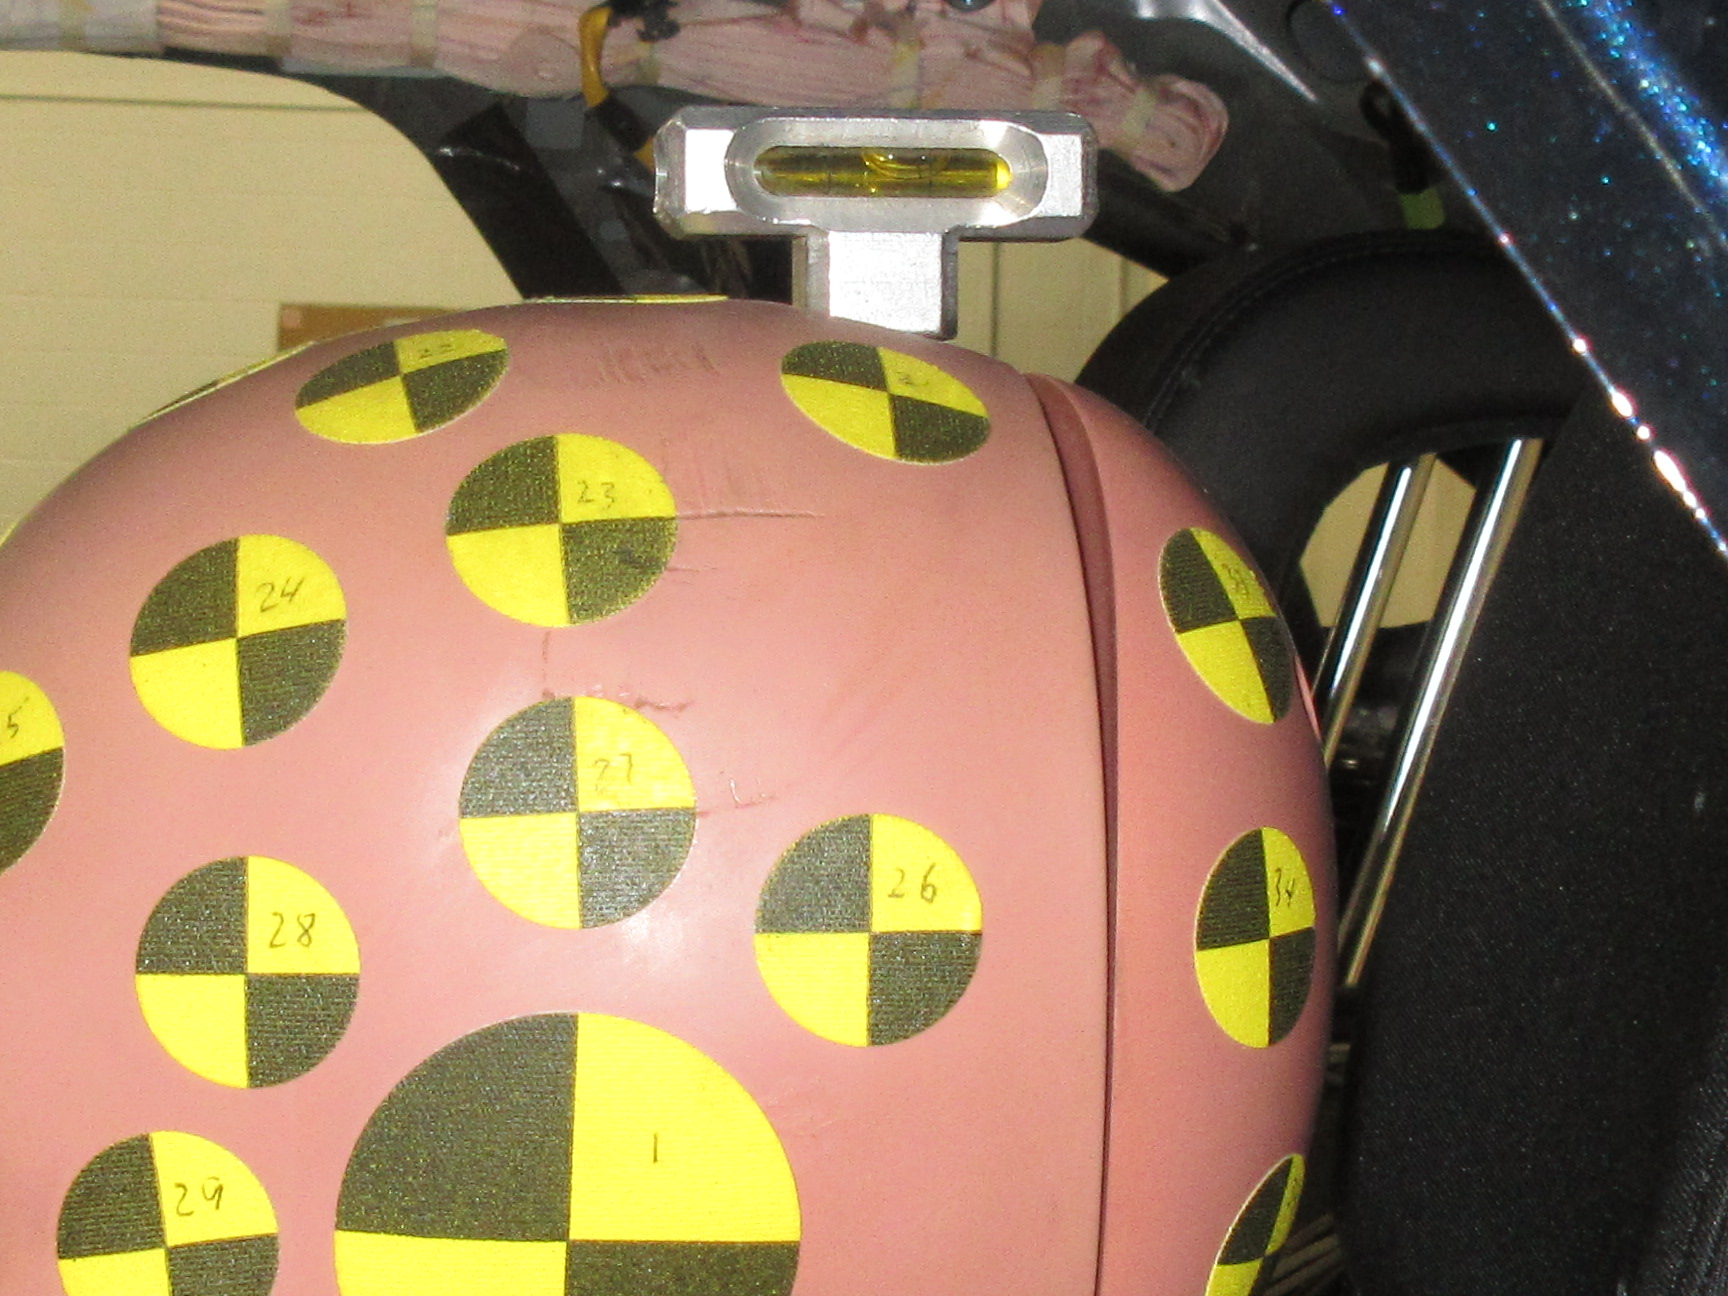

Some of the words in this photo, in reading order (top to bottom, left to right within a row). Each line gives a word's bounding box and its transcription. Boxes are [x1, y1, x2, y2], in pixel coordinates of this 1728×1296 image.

[577, 481, 615, 509] 23
[255, 577, 305, 613] 24
[592, 753, 633, 785] 27
[887, 863, 936, 903] 26
[269, 912, 317, 948] 28
[174, 1176, 224, 1216] 29
